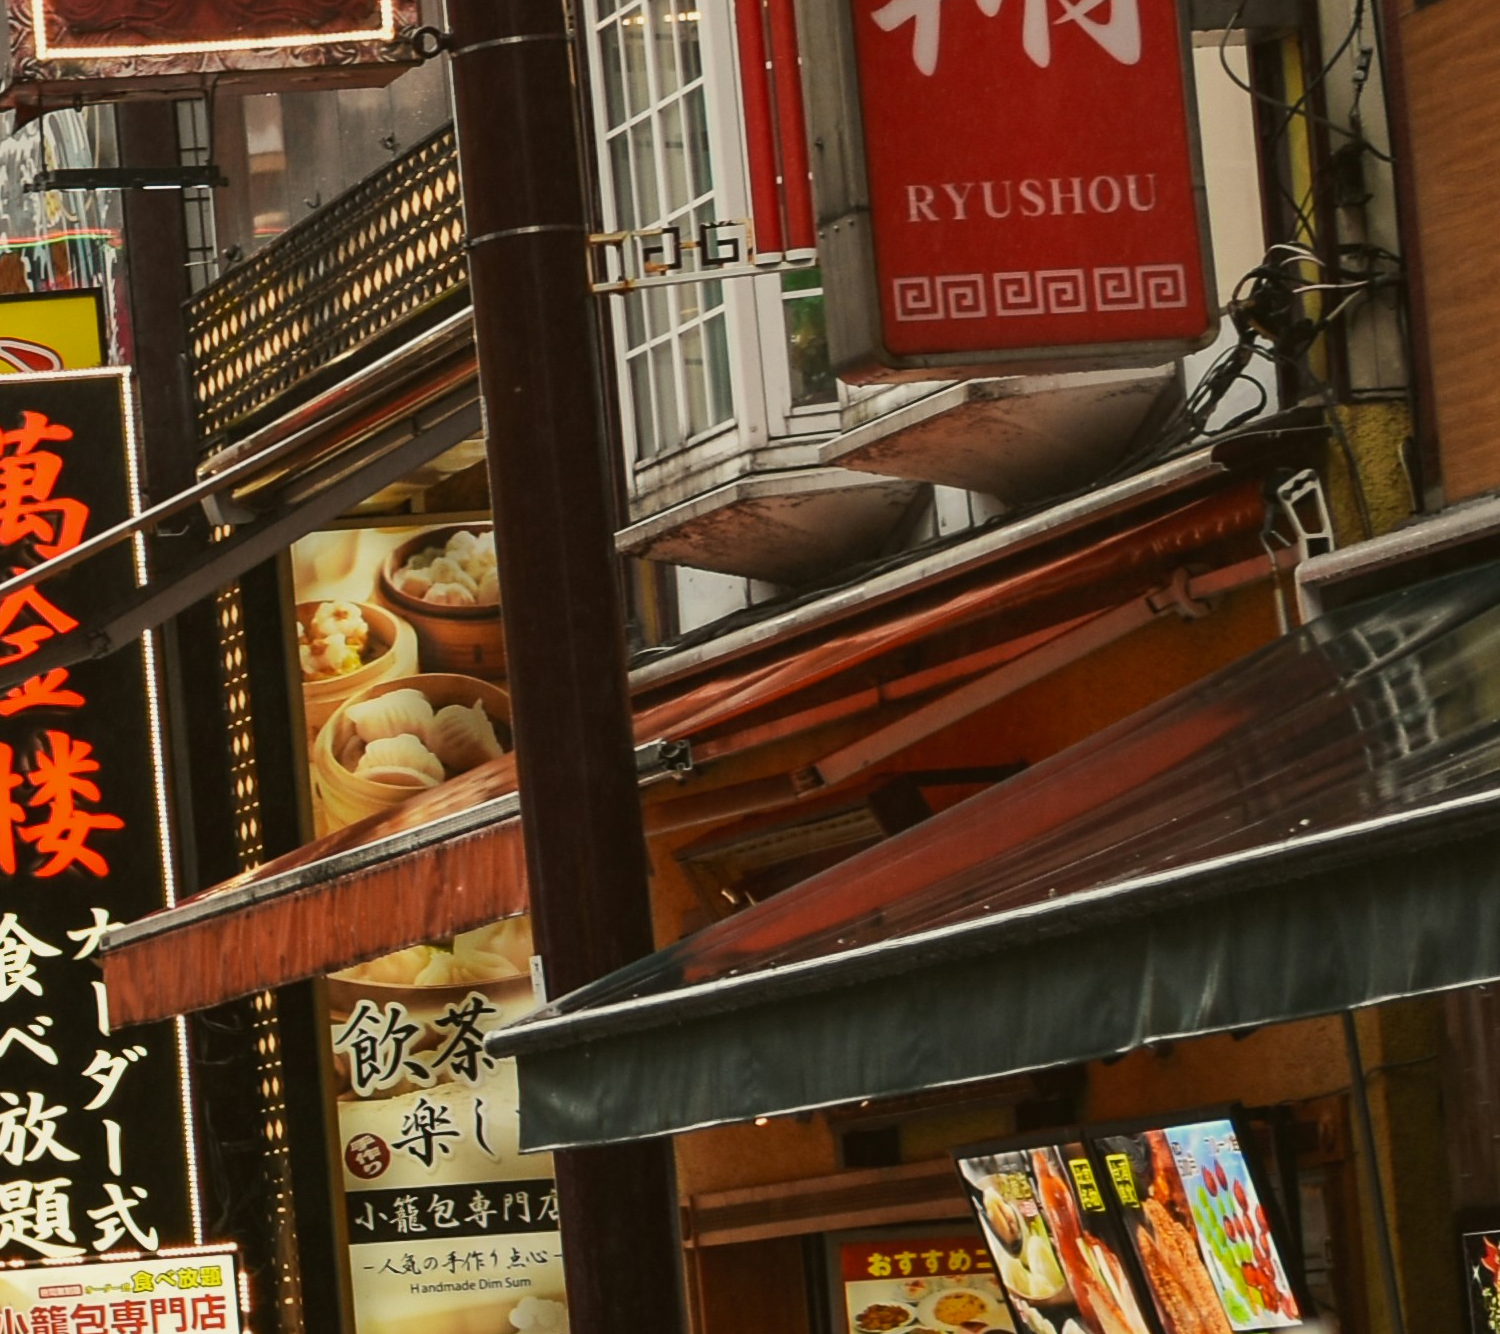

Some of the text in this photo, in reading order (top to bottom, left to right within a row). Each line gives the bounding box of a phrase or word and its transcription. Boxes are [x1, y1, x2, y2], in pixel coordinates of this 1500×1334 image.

[906, 174, 1156, 222] RYUSHOU
[131, 1265, 223, 1294] 食べ放題
[411, 1275, 532, 1295] Handmade Dim Sum
